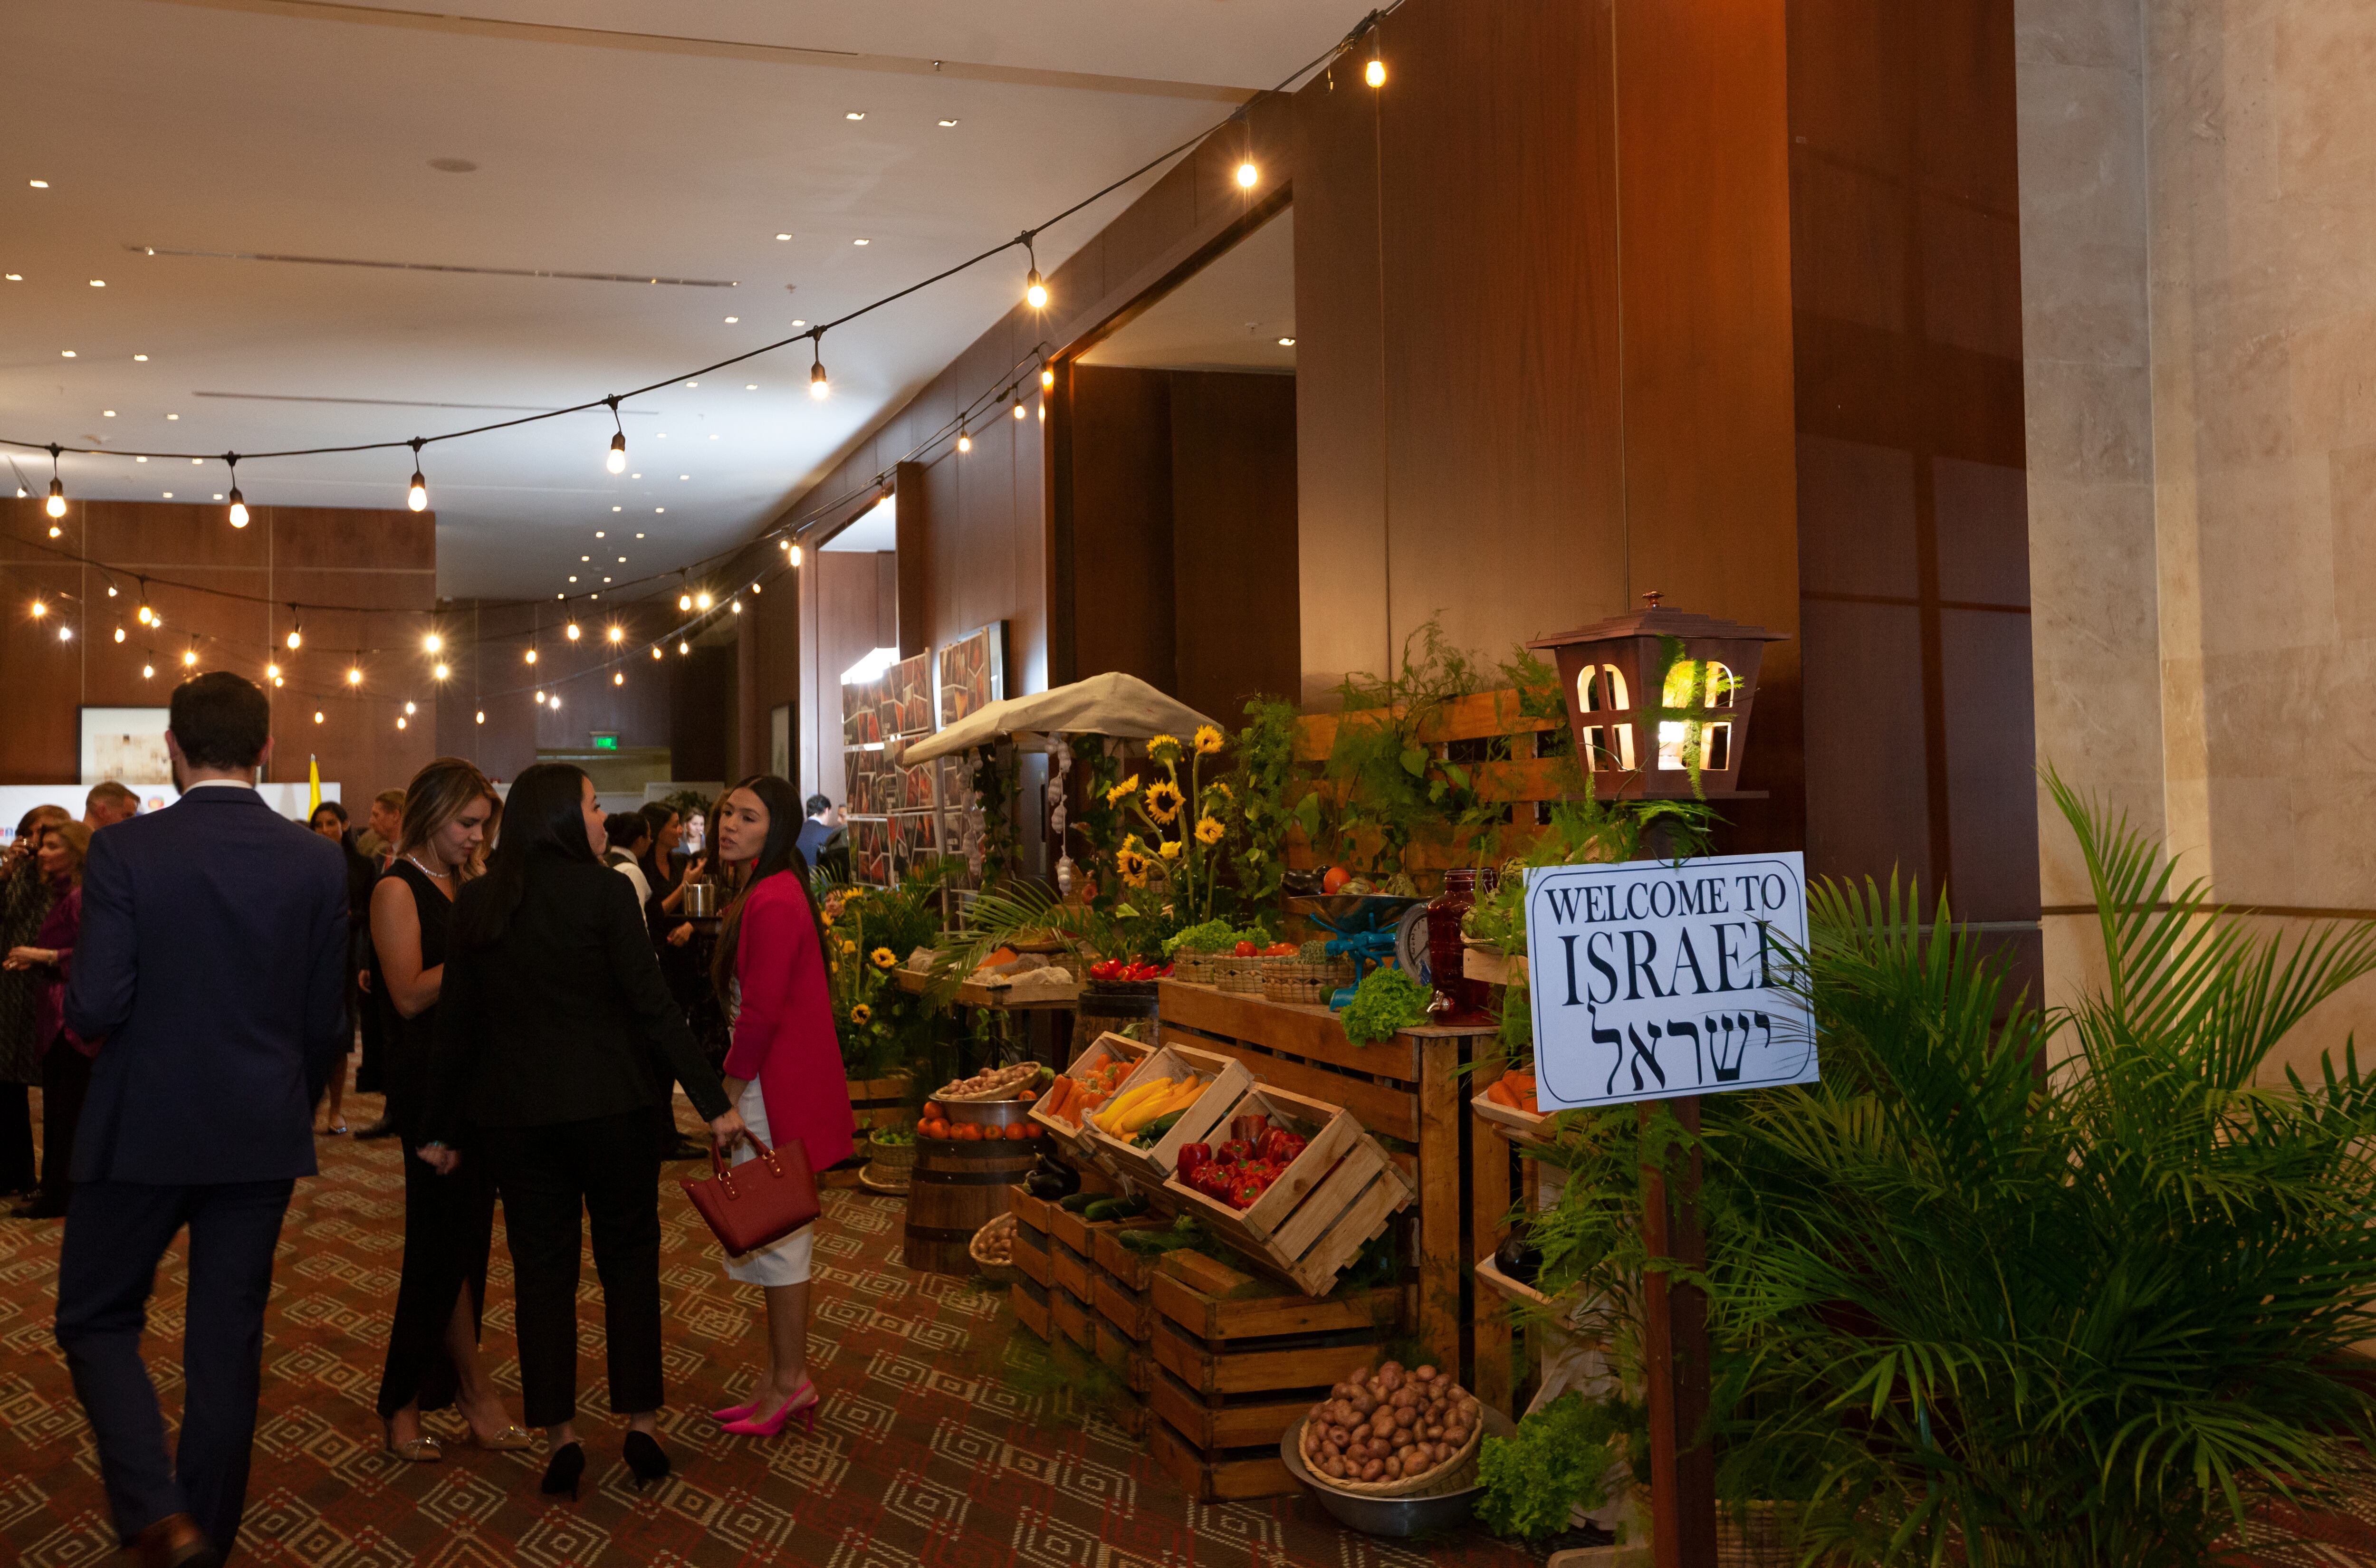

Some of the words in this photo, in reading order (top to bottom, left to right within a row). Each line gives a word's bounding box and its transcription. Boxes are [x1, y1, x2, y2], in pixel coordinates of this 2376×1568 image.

[1544, 877, 1729, 925] WELCOME
[1735, 874, 1786, 911] TO
[1558, 920, 1795, 1006] ISRAEL
[1587, 998, 1771, 1095] ישראל
